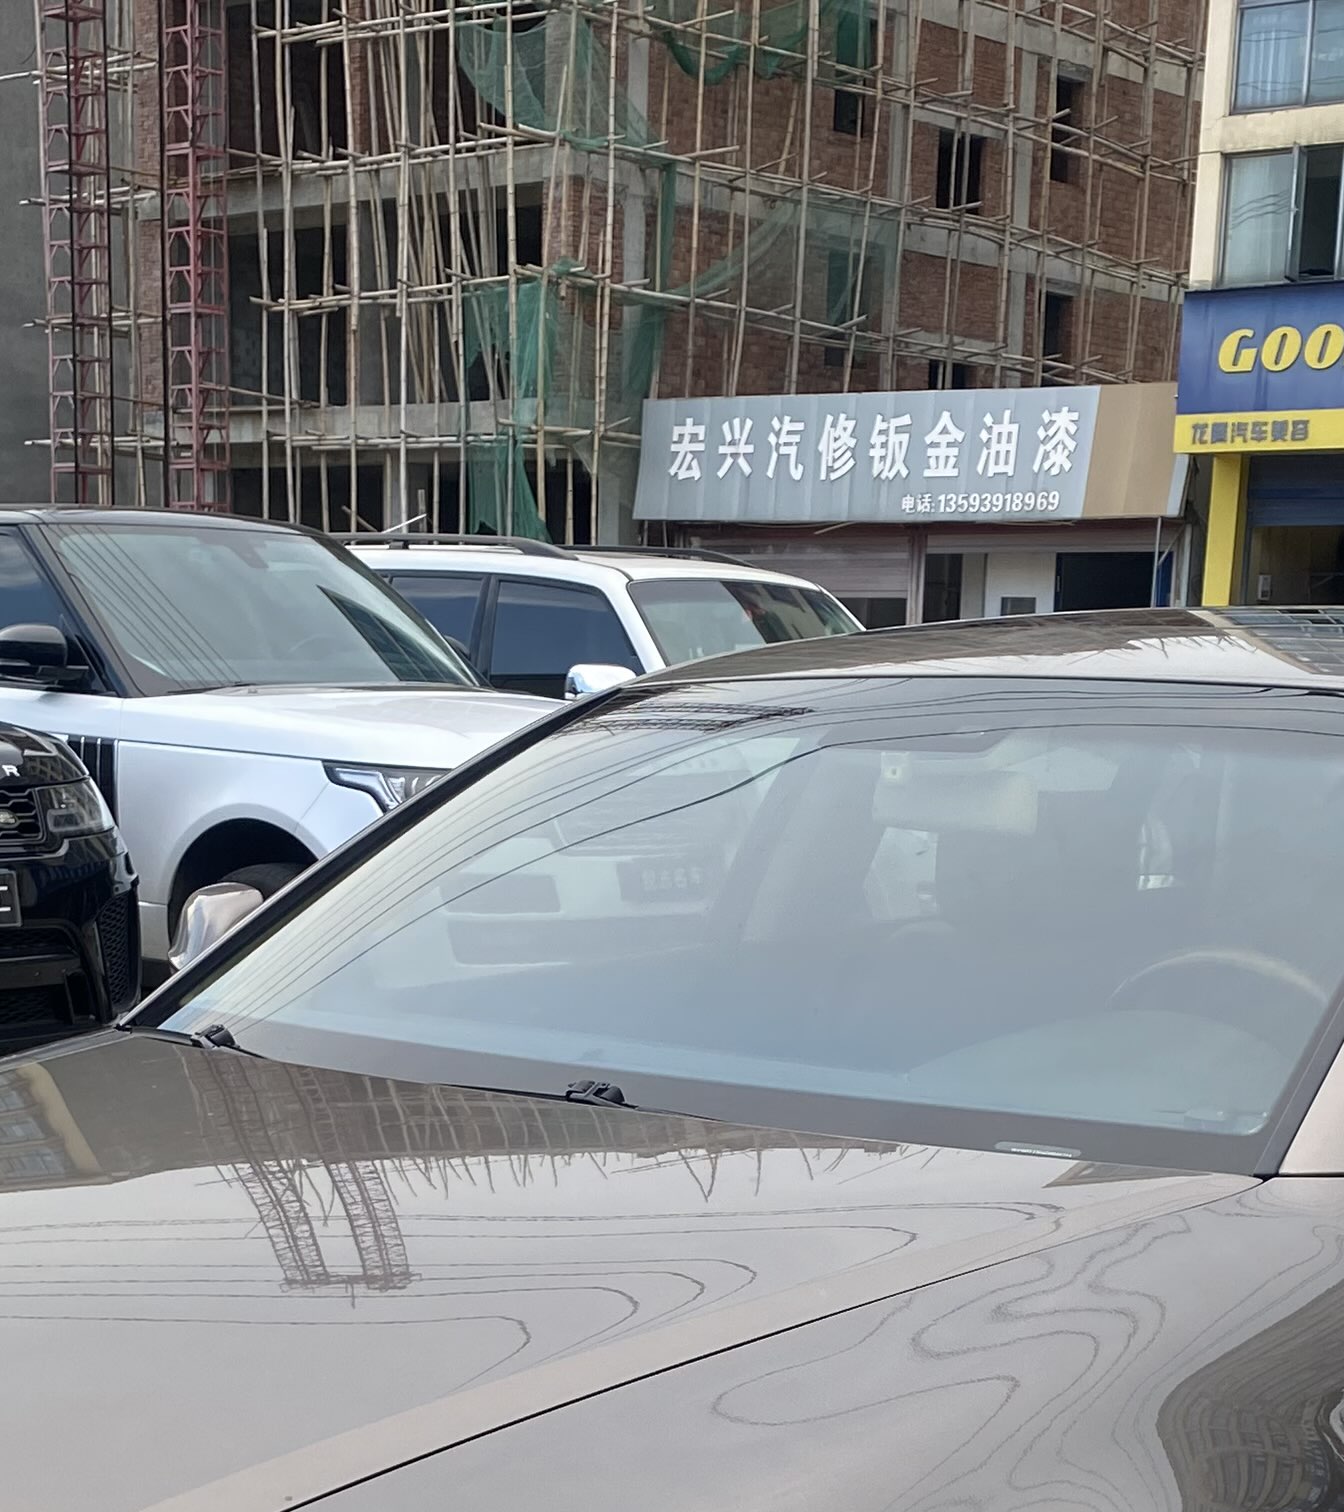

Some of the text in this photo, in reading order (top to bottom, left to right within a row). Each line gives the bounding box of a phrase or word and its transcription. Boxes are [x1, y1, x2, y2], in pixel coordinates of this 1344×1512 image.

[667, 405, 1081, 482] 宏兴汽修钣金油漆
